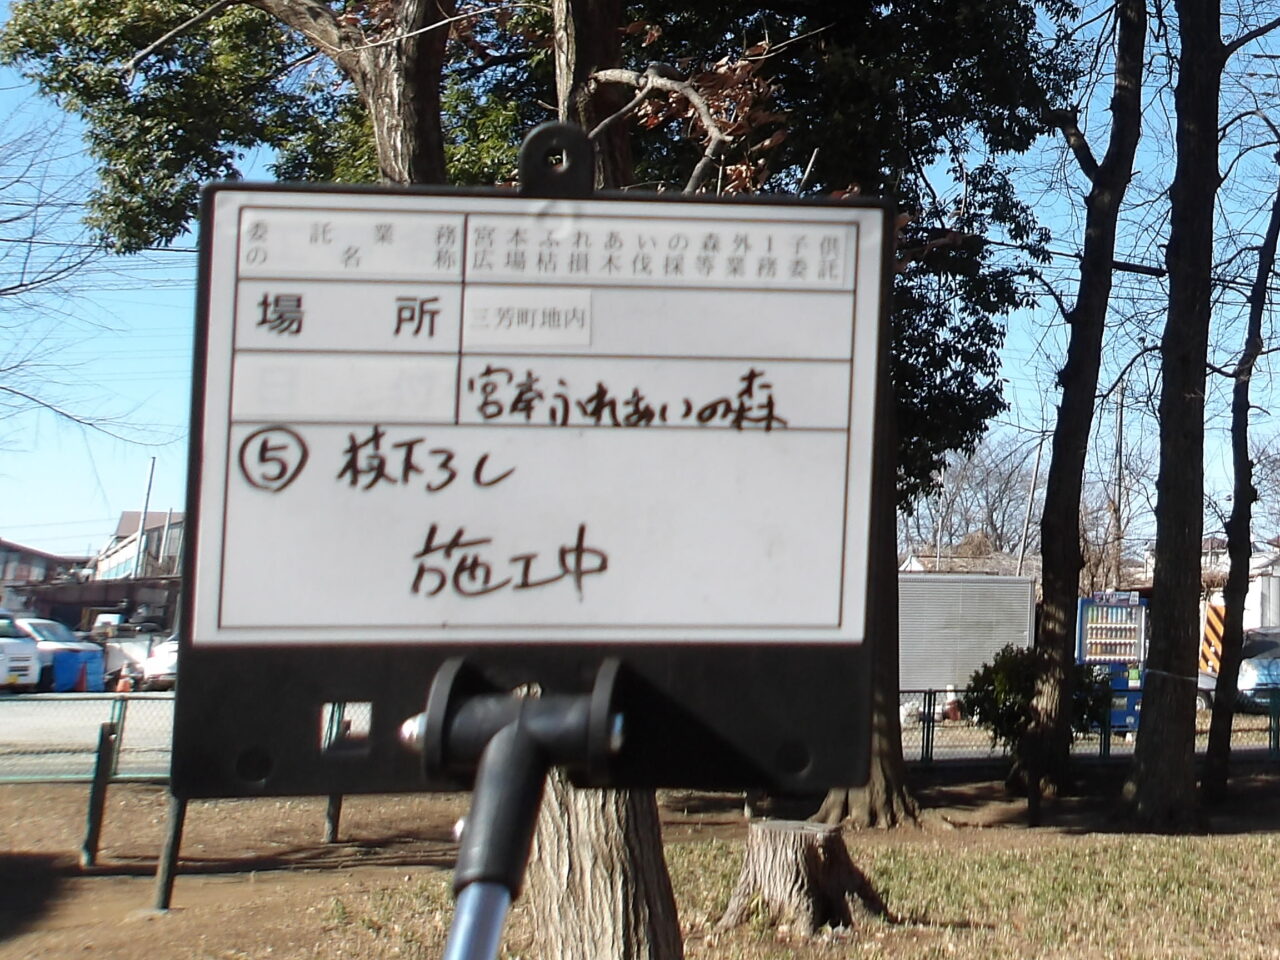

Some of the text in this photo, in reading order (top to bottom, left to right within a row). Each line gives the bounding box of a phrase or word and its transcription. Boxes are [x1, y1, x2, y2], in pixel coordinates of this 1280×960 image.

[249, 219, 457, 246] 委託業務
[246, 245, 456, 270] の名称
[256, 292, 441, 338] 場所
[470, 306, 586, 330] 三芳町地内
[467, 366, 789, 431] 宮本ふれあいの森
[335, 425, 516, 492] 枝下ろし
[410, 522, 610, 603] 施工中
